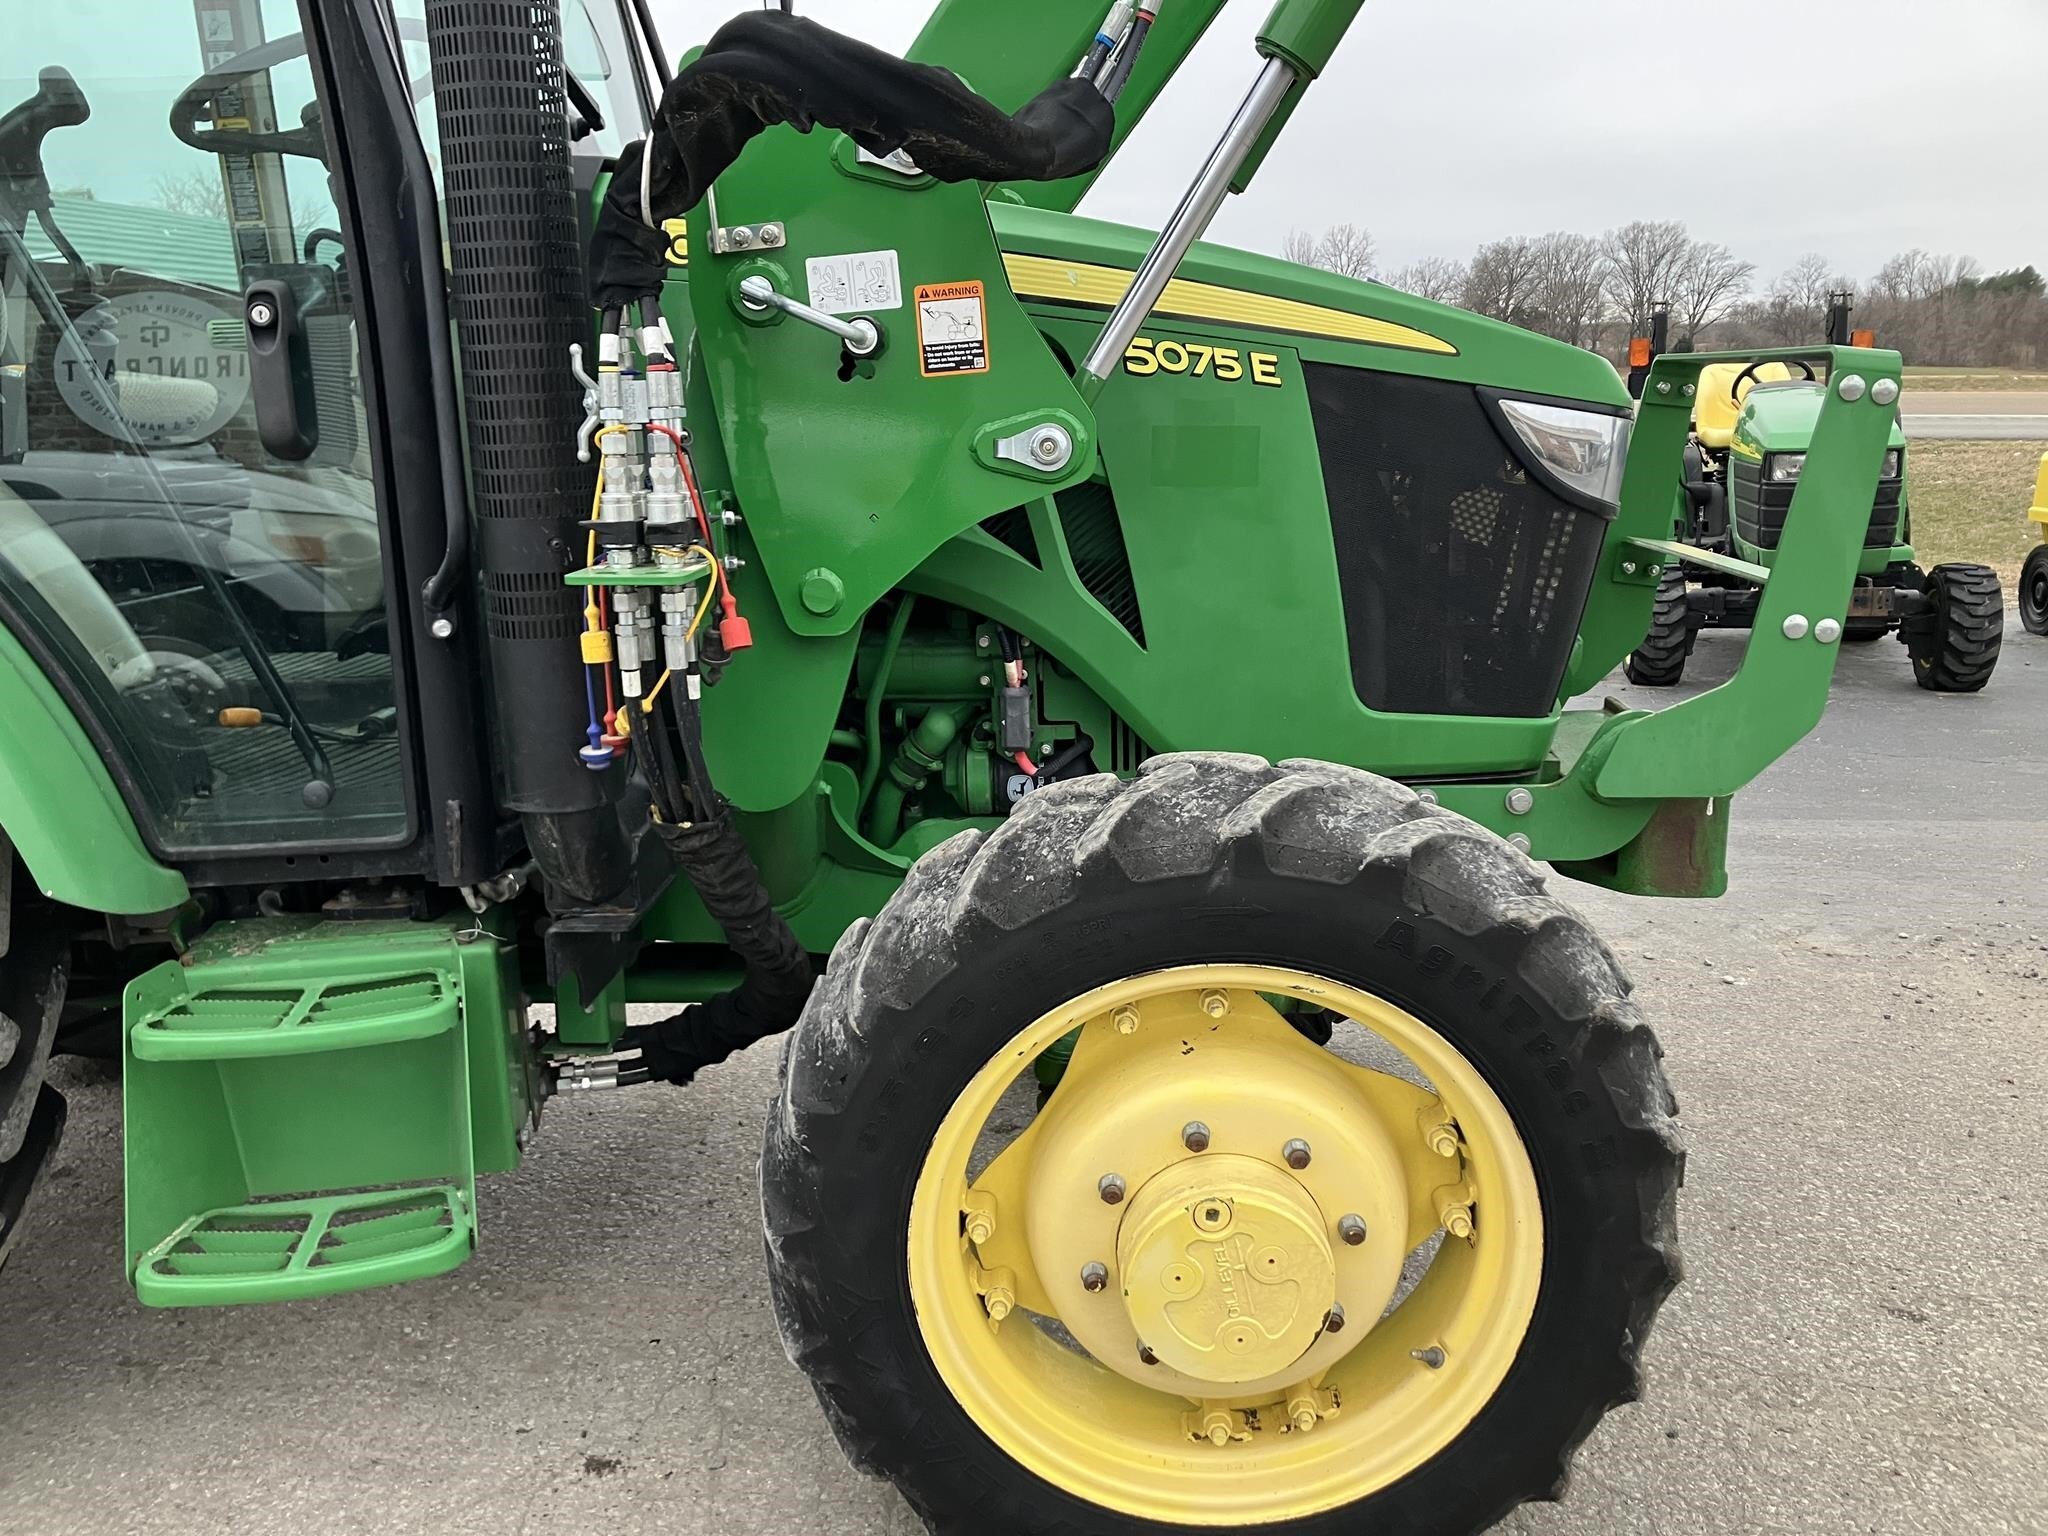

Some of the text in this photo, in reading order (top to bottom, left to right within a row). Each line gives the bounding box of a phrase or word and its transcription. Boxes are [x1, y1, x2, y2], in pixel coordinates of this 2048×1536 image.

[932, 286, 979, 298] WARNING
[1123, 336, 1282, 388] 5075 E
